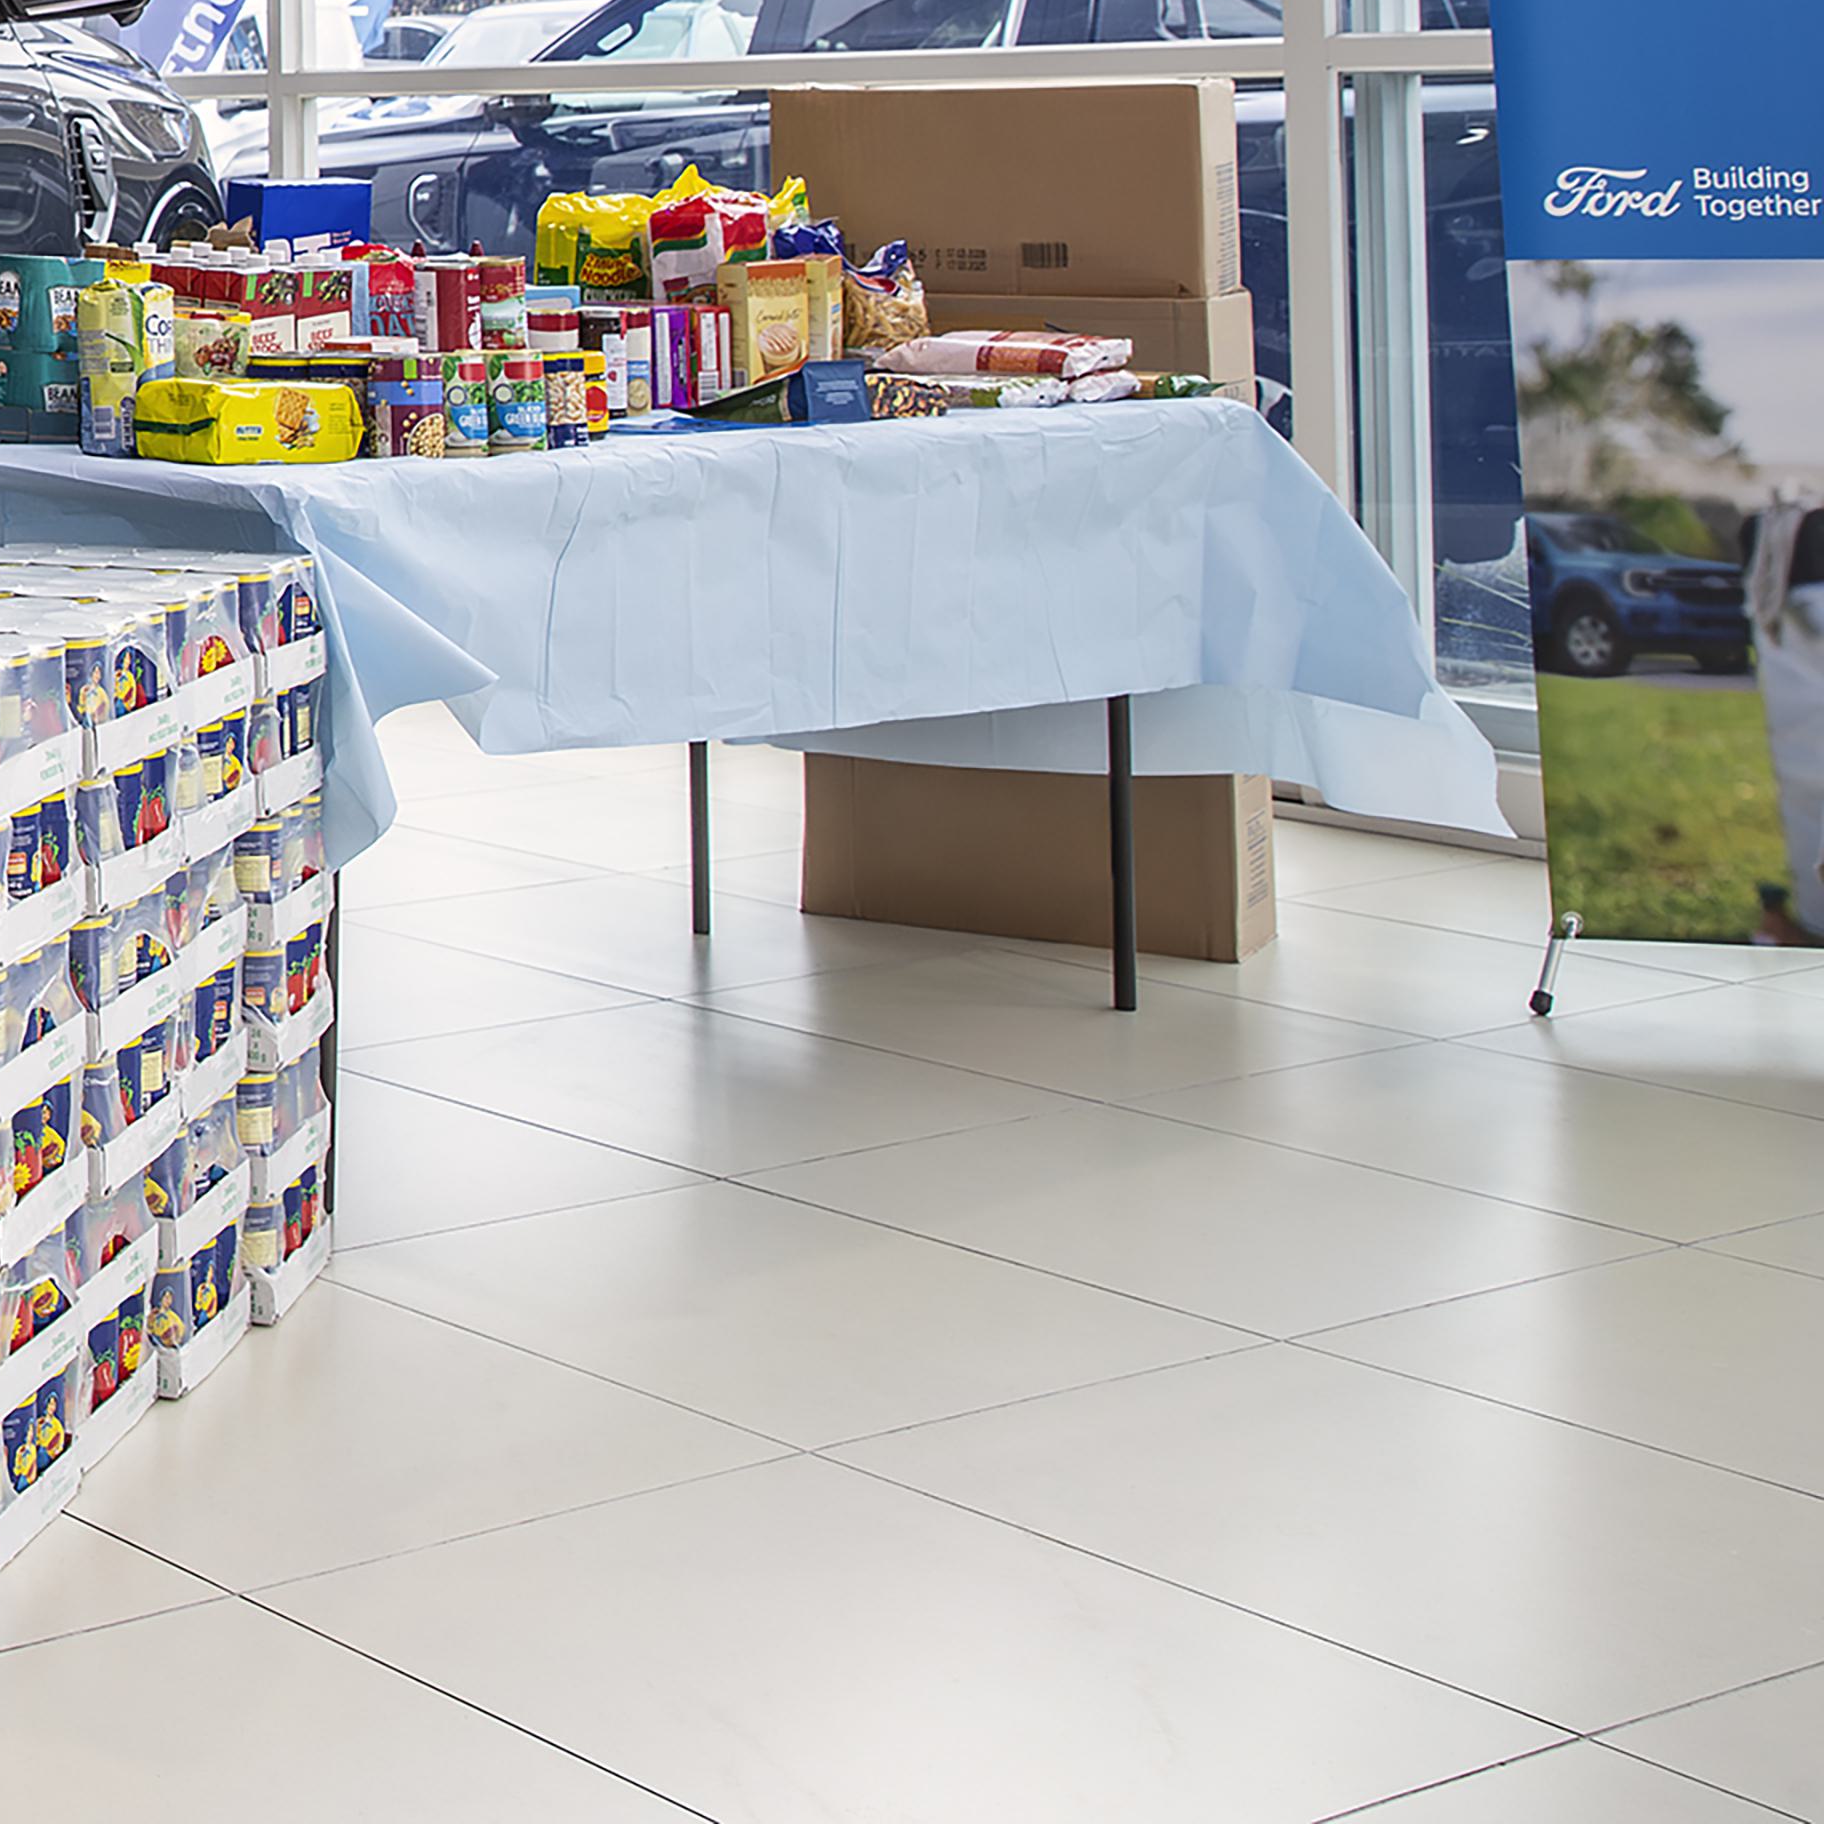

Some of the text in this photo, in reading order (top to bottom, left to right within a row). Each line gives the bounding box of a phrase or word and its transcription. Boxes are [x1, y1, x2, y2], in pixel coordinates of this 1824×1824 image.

[1543, 165, 1684, 217] Ford
[1692, 165, 1810, 193] Building
[1693, 194, 1823, 221] Together
